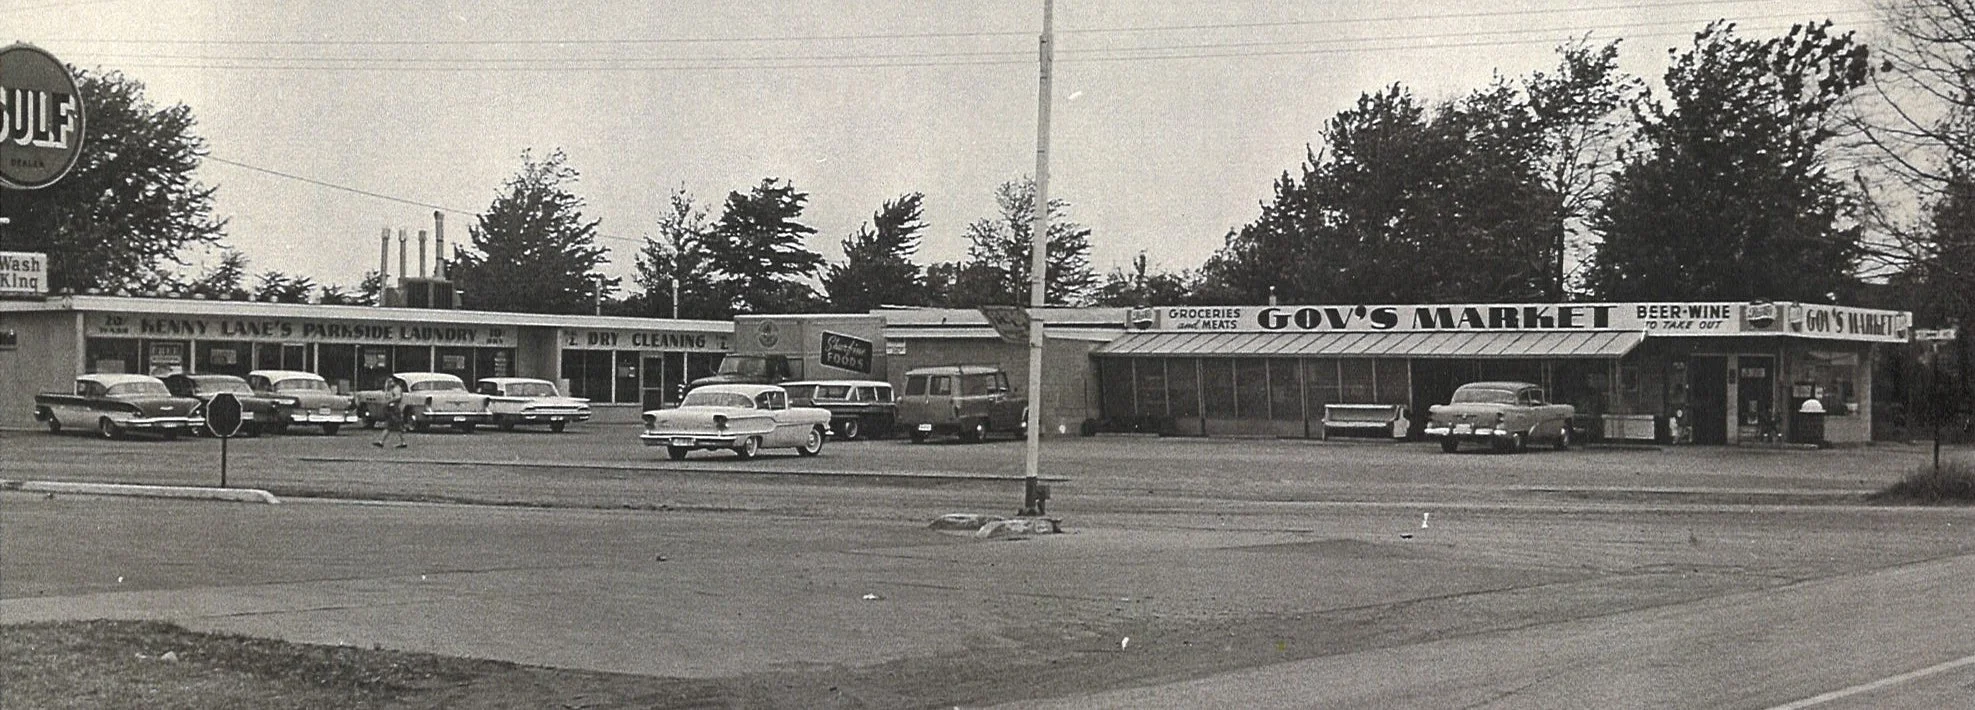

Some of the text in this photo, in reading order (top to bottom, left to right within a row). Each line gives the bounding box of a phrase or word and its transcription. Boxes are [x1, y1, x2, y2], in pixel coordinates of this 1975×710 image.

[0, 256, 40, 272] Wash
[0, 273, 38, 293] King
[1169, 308, 1241, 319] GROCERIES
[1257, 306, 1618, 330] GOV'S MARKET
[1636, 305, 1730, 319] BEER-WINE
[141, 318, 477, 342] KENNY LANE'S PARKSIDE LAUNDRY
[1177, 319, 1237, 330] and MEATS
[1663, 320, 1694, 330] TAKE
[1699, 320, 1724, 330] OUT
[1806, 307, 1844, 334] GOV'S
[1848, 311, 1892, 336] MARKET
[587, 331, 620, 347] DRY
[632, 332, 706, 348] CLEANING
[827, 352, 865, 369] FOODS
